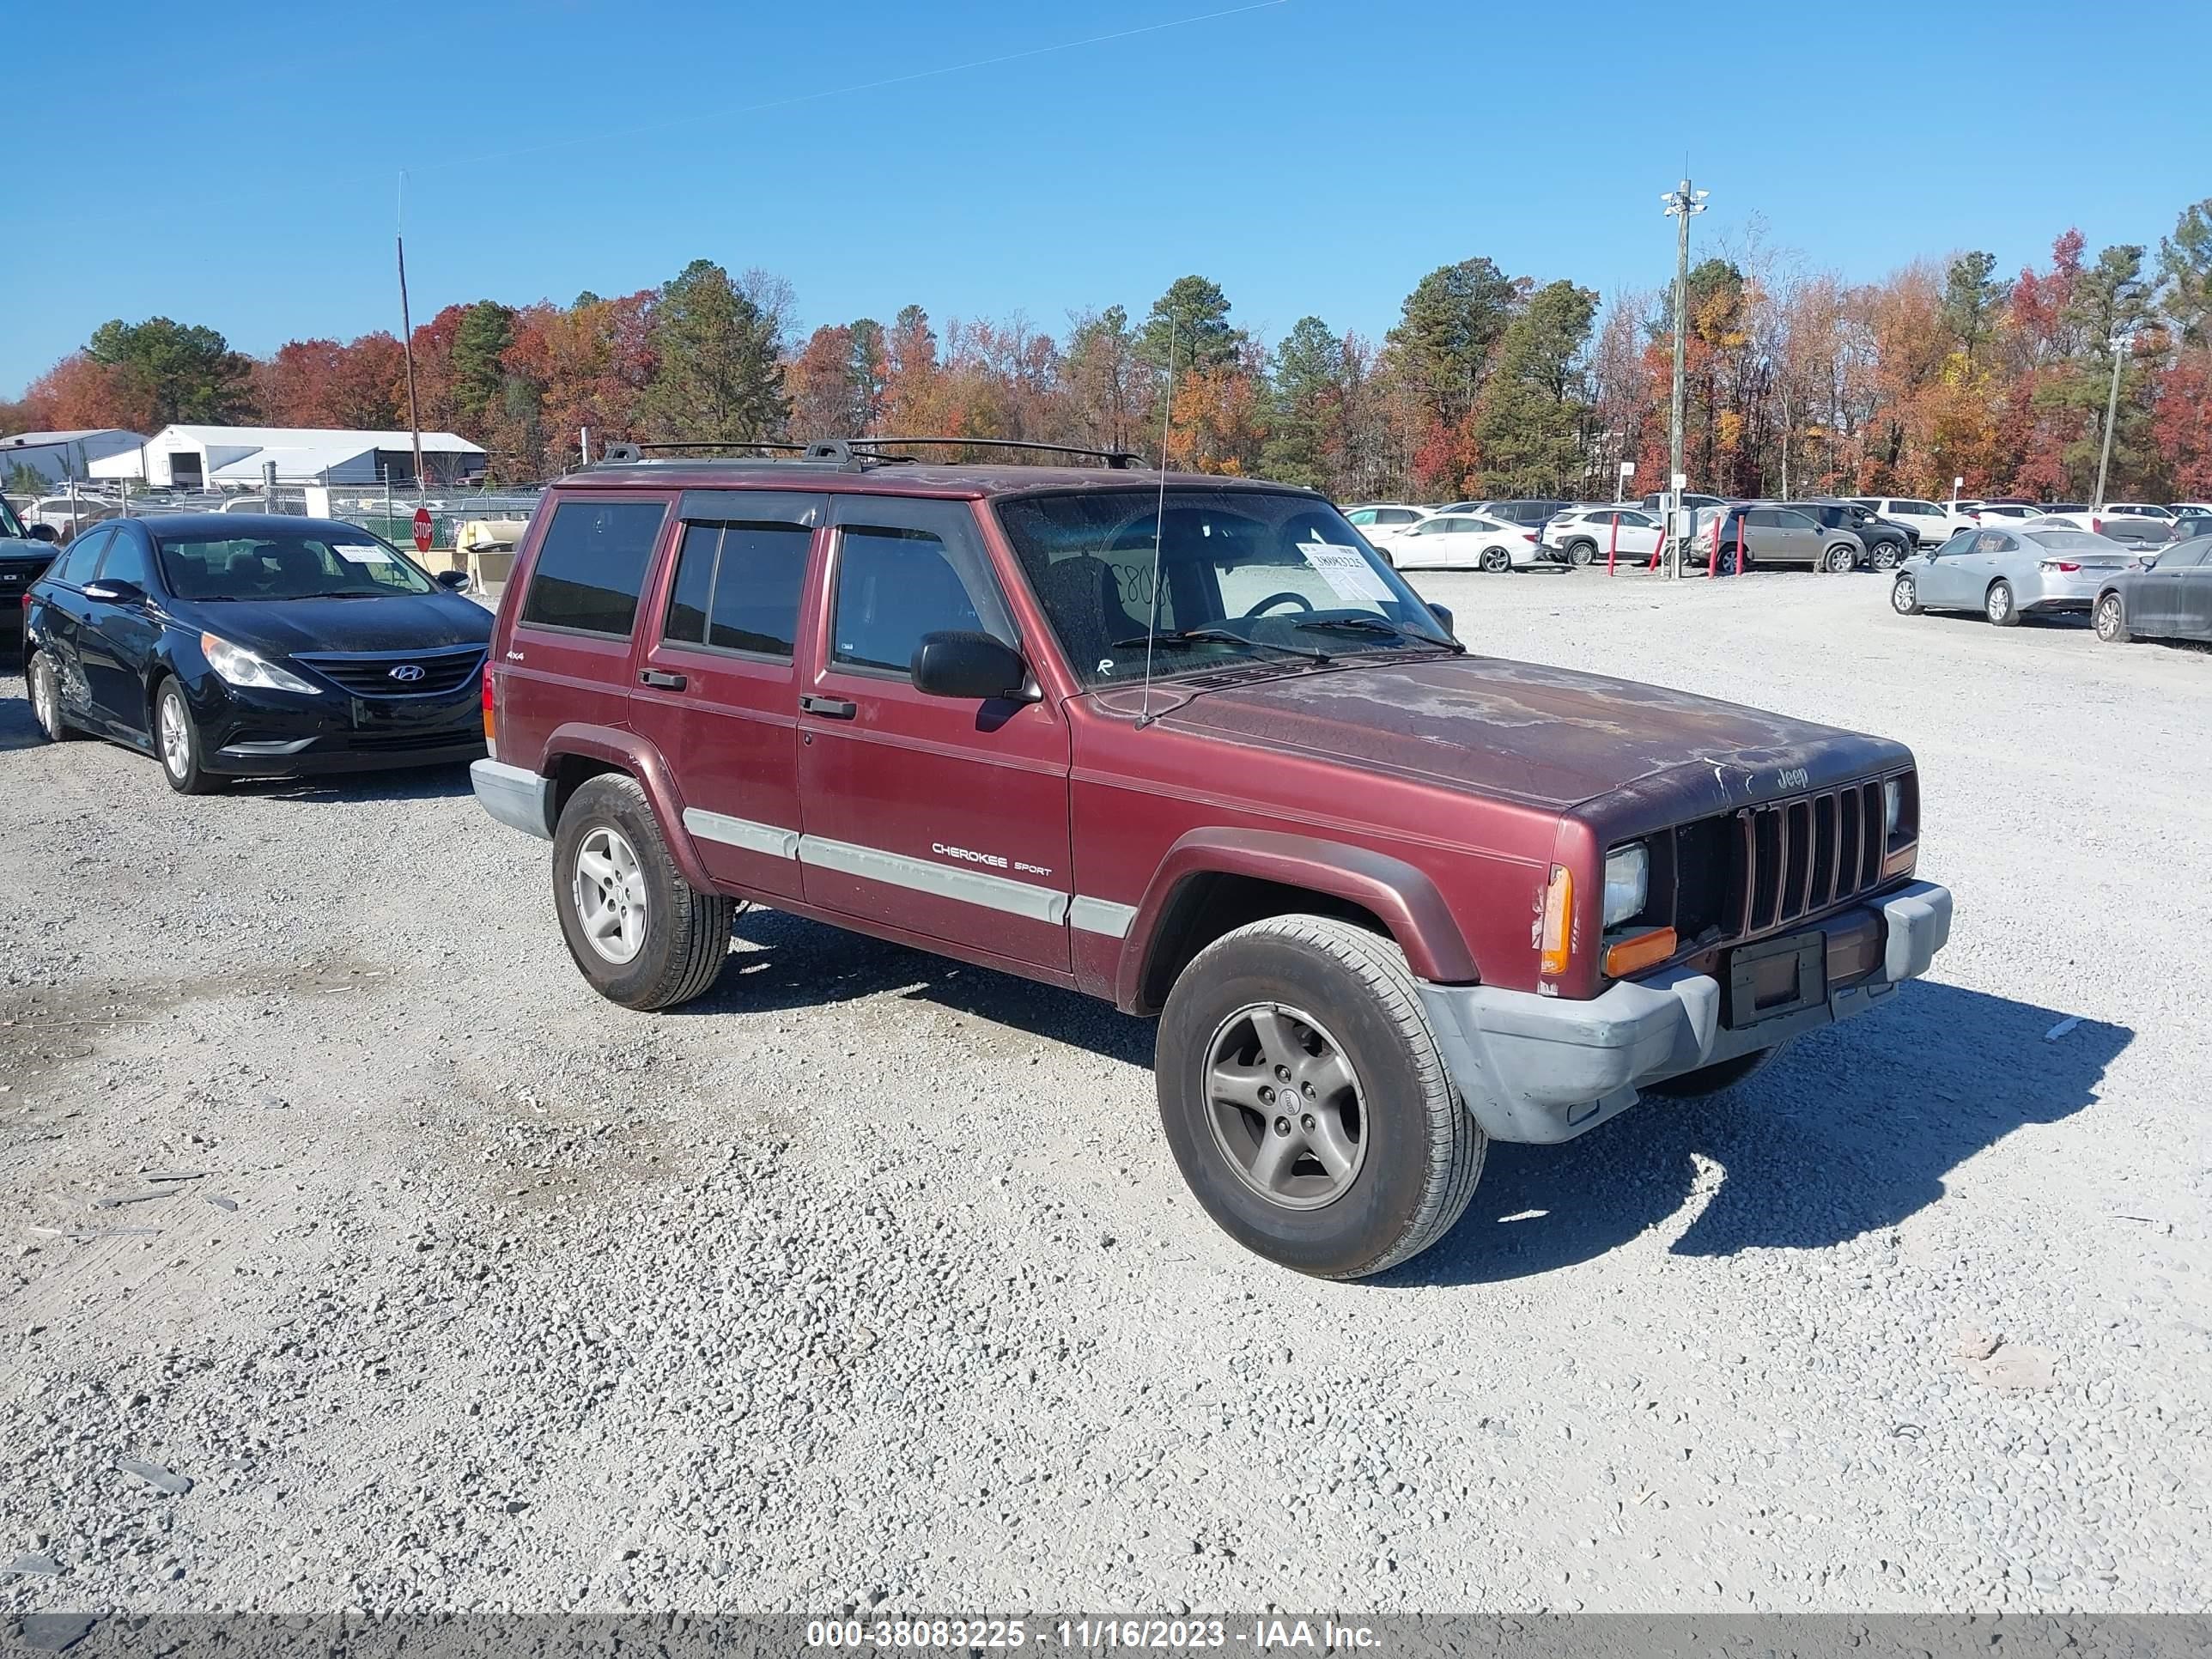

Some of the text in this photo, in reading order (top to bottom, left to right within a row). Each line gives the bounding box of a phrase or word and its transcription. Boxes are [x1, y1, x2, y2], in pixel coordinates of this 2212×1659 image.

[414, 520, 432, 539] STOP
[1096, 659, 1115, 677] R
[1778, 767, 1809, 790] Jeep
[932, 842, 1053, 877] CHEROKEE SPORT
